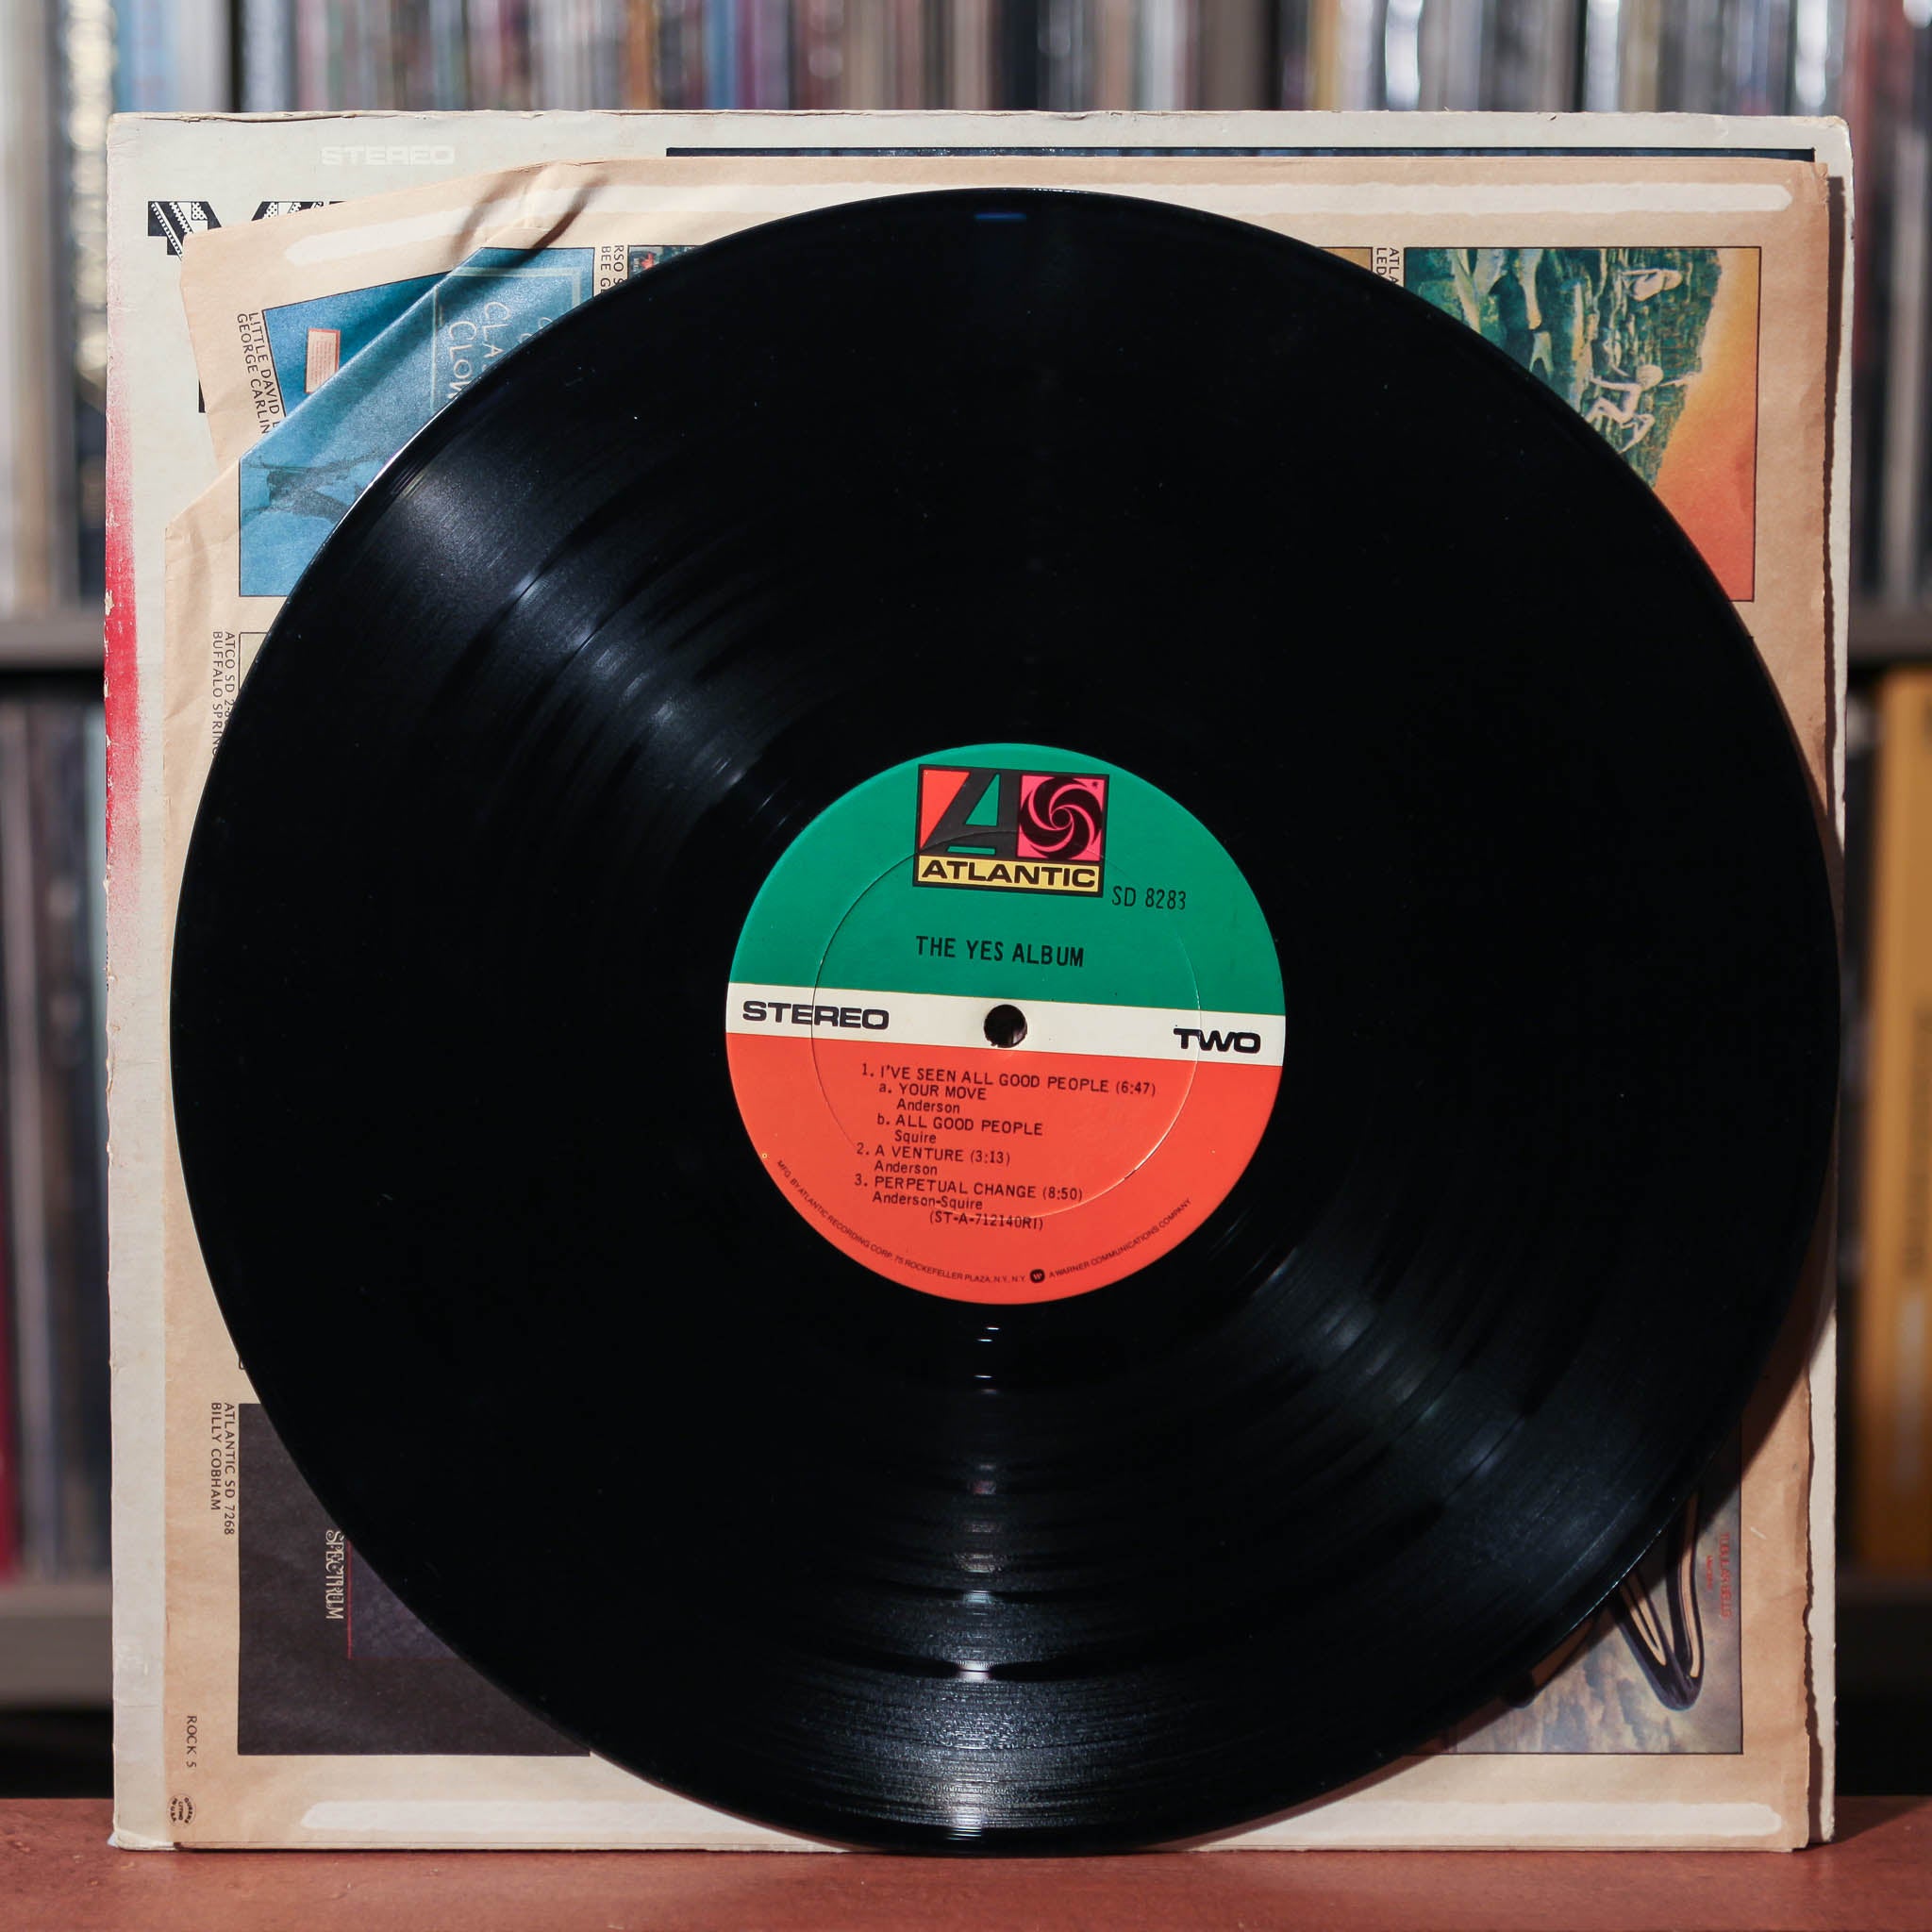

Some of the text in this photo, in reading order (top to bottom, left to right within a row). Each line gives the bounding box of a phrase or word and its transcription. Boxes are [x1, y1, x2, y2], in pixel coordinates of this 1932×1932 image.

[321, 145, 456, 166] STEREO
[601, 246, 611, 271] BEE
[614, 245, 625, 273] RSO
[1376, 247, 1388, 275] LED
[482, 301, 512, 372] CLA
[237, 313, 271, 435] GEORGE CARLIN
[249, 312, 269, 363] LITTLE
[260, 369, 280, 415] DAVID
[212, 631, 224, 698] BUFFALO
[225, 631, 236, 669] ATCO
[225, 675, 236, 693] SD
[922, 859, 1096, 888] ATLANTIC
[1111, 885, 1187, 910] SD 8283
[916, 936, 1084, 968] THE YES ALBUM
[742, 1000, 890, 1030] STEREO
[1174, 1027, 1261, 1054] TWO
[862, 1063, 1156, 1097] 1. I'VE SEEN ALL GOOD PEOPLE (6:47)
[878, 1083, 987, 1100] a. YOUR MOVE
[896, 1098, 960, 1113] Anderson
[877, 1113, 1042, 1136] b. ALL GOOD PEOPLE
[894, 1129, 937, 1144] Squire
[857, 1142, 1010, 1167] 2. A VENTURE (3:13)
[874, 1160, 938, 1175] Anderson
[854, 1173, 1083, 1202] 3. PERPETUAL CHANGE (8:50)
[872, 1191, 983, 1209] Anderson-Squire
[798, 1188, 828, 1218] ATLANTIC
[827, 1215, 871, 1248] RECORDING
[905, 1259, 964, 1280] ROCKEFELLER
[1055, 1260, 1091, 1277] WARNER
[1091, 1225, 1159, 1267] COMMUNICATIONS
[1158, 1197, 1192, 1229] COMPANY
[210, 1402, 222, 1510] BILLY COBHAM
[224, 1402, 236, 1535] ATLANTIC SD 7268
[325, 1529, 345, 1620] SPECTRUM
[186, 1715, 197, 1755] ROCK
